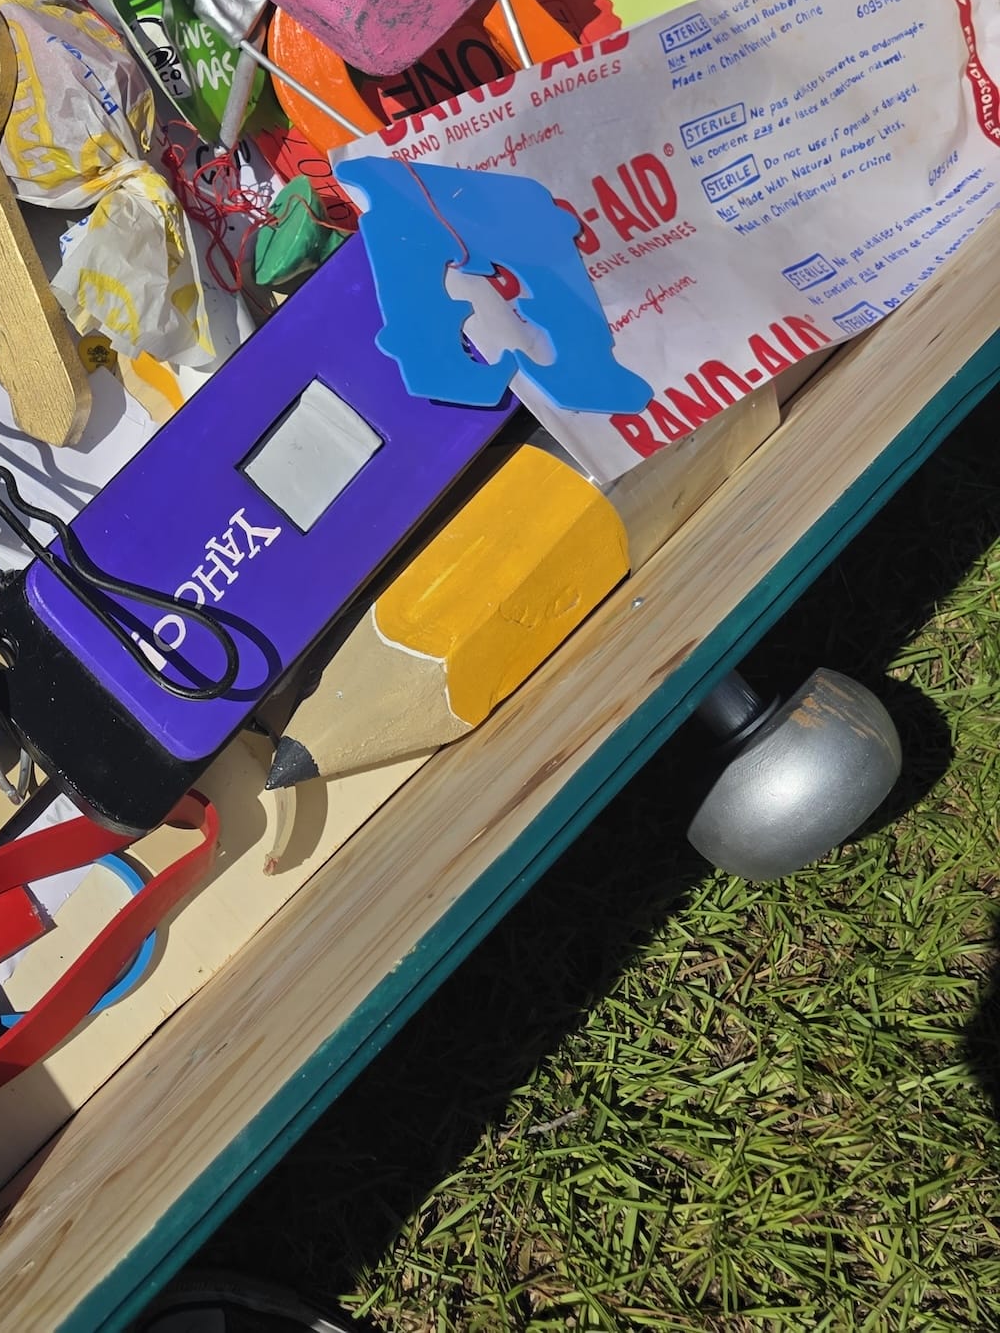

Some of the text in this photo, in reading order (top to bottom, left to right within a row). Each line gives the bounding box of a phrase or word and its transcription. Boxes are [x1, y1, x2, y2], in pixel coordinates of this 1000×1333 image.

[665, 16, 708, 48] STERILE
[669, 3, 824, 92] Made Chine
[687, 39, 713, 60] Made
[446, 104, 517, 144] ADHESIVE
[529, 59, 623, 109] BANDAGES
[685, 95, 791, 145] STERILE pas
[706, 110, 873, 198] STERILE not use opened
[736, 131, 877, 210] Made With Natural Rubber
[629, 221, 696, 258] BANDAGES
[789, 256, 831, 291] STERILE
